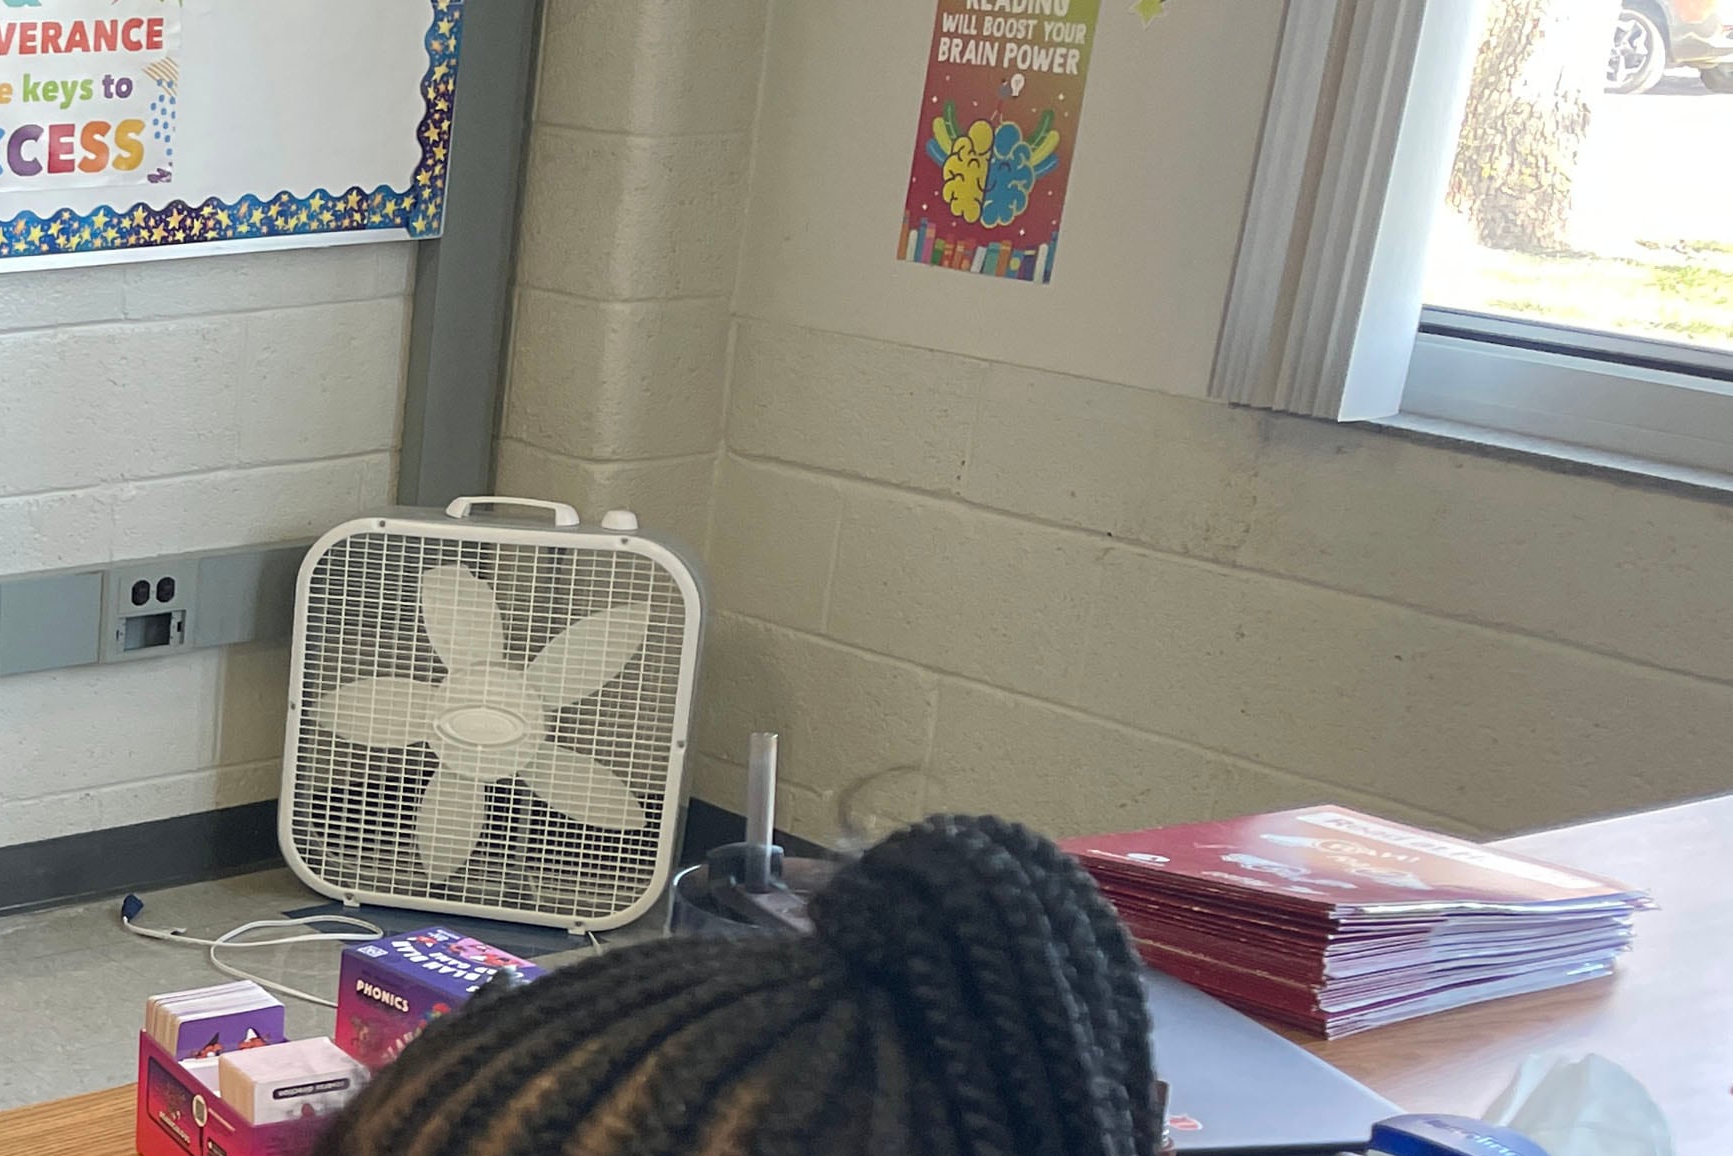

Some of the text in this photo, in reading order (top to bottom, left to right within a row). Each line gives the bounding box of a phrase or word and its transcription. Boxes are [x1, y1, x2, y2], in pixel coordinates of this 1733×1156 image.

[942, 12, 1087, 44] WILL BOOST YOUR
[937, 37, 1080, 75] BRAIN POWER
[22, 72, 94, 110] keys
[102, 73, 134, 99] to
[356, 979, 410, 1013] PHONICS
